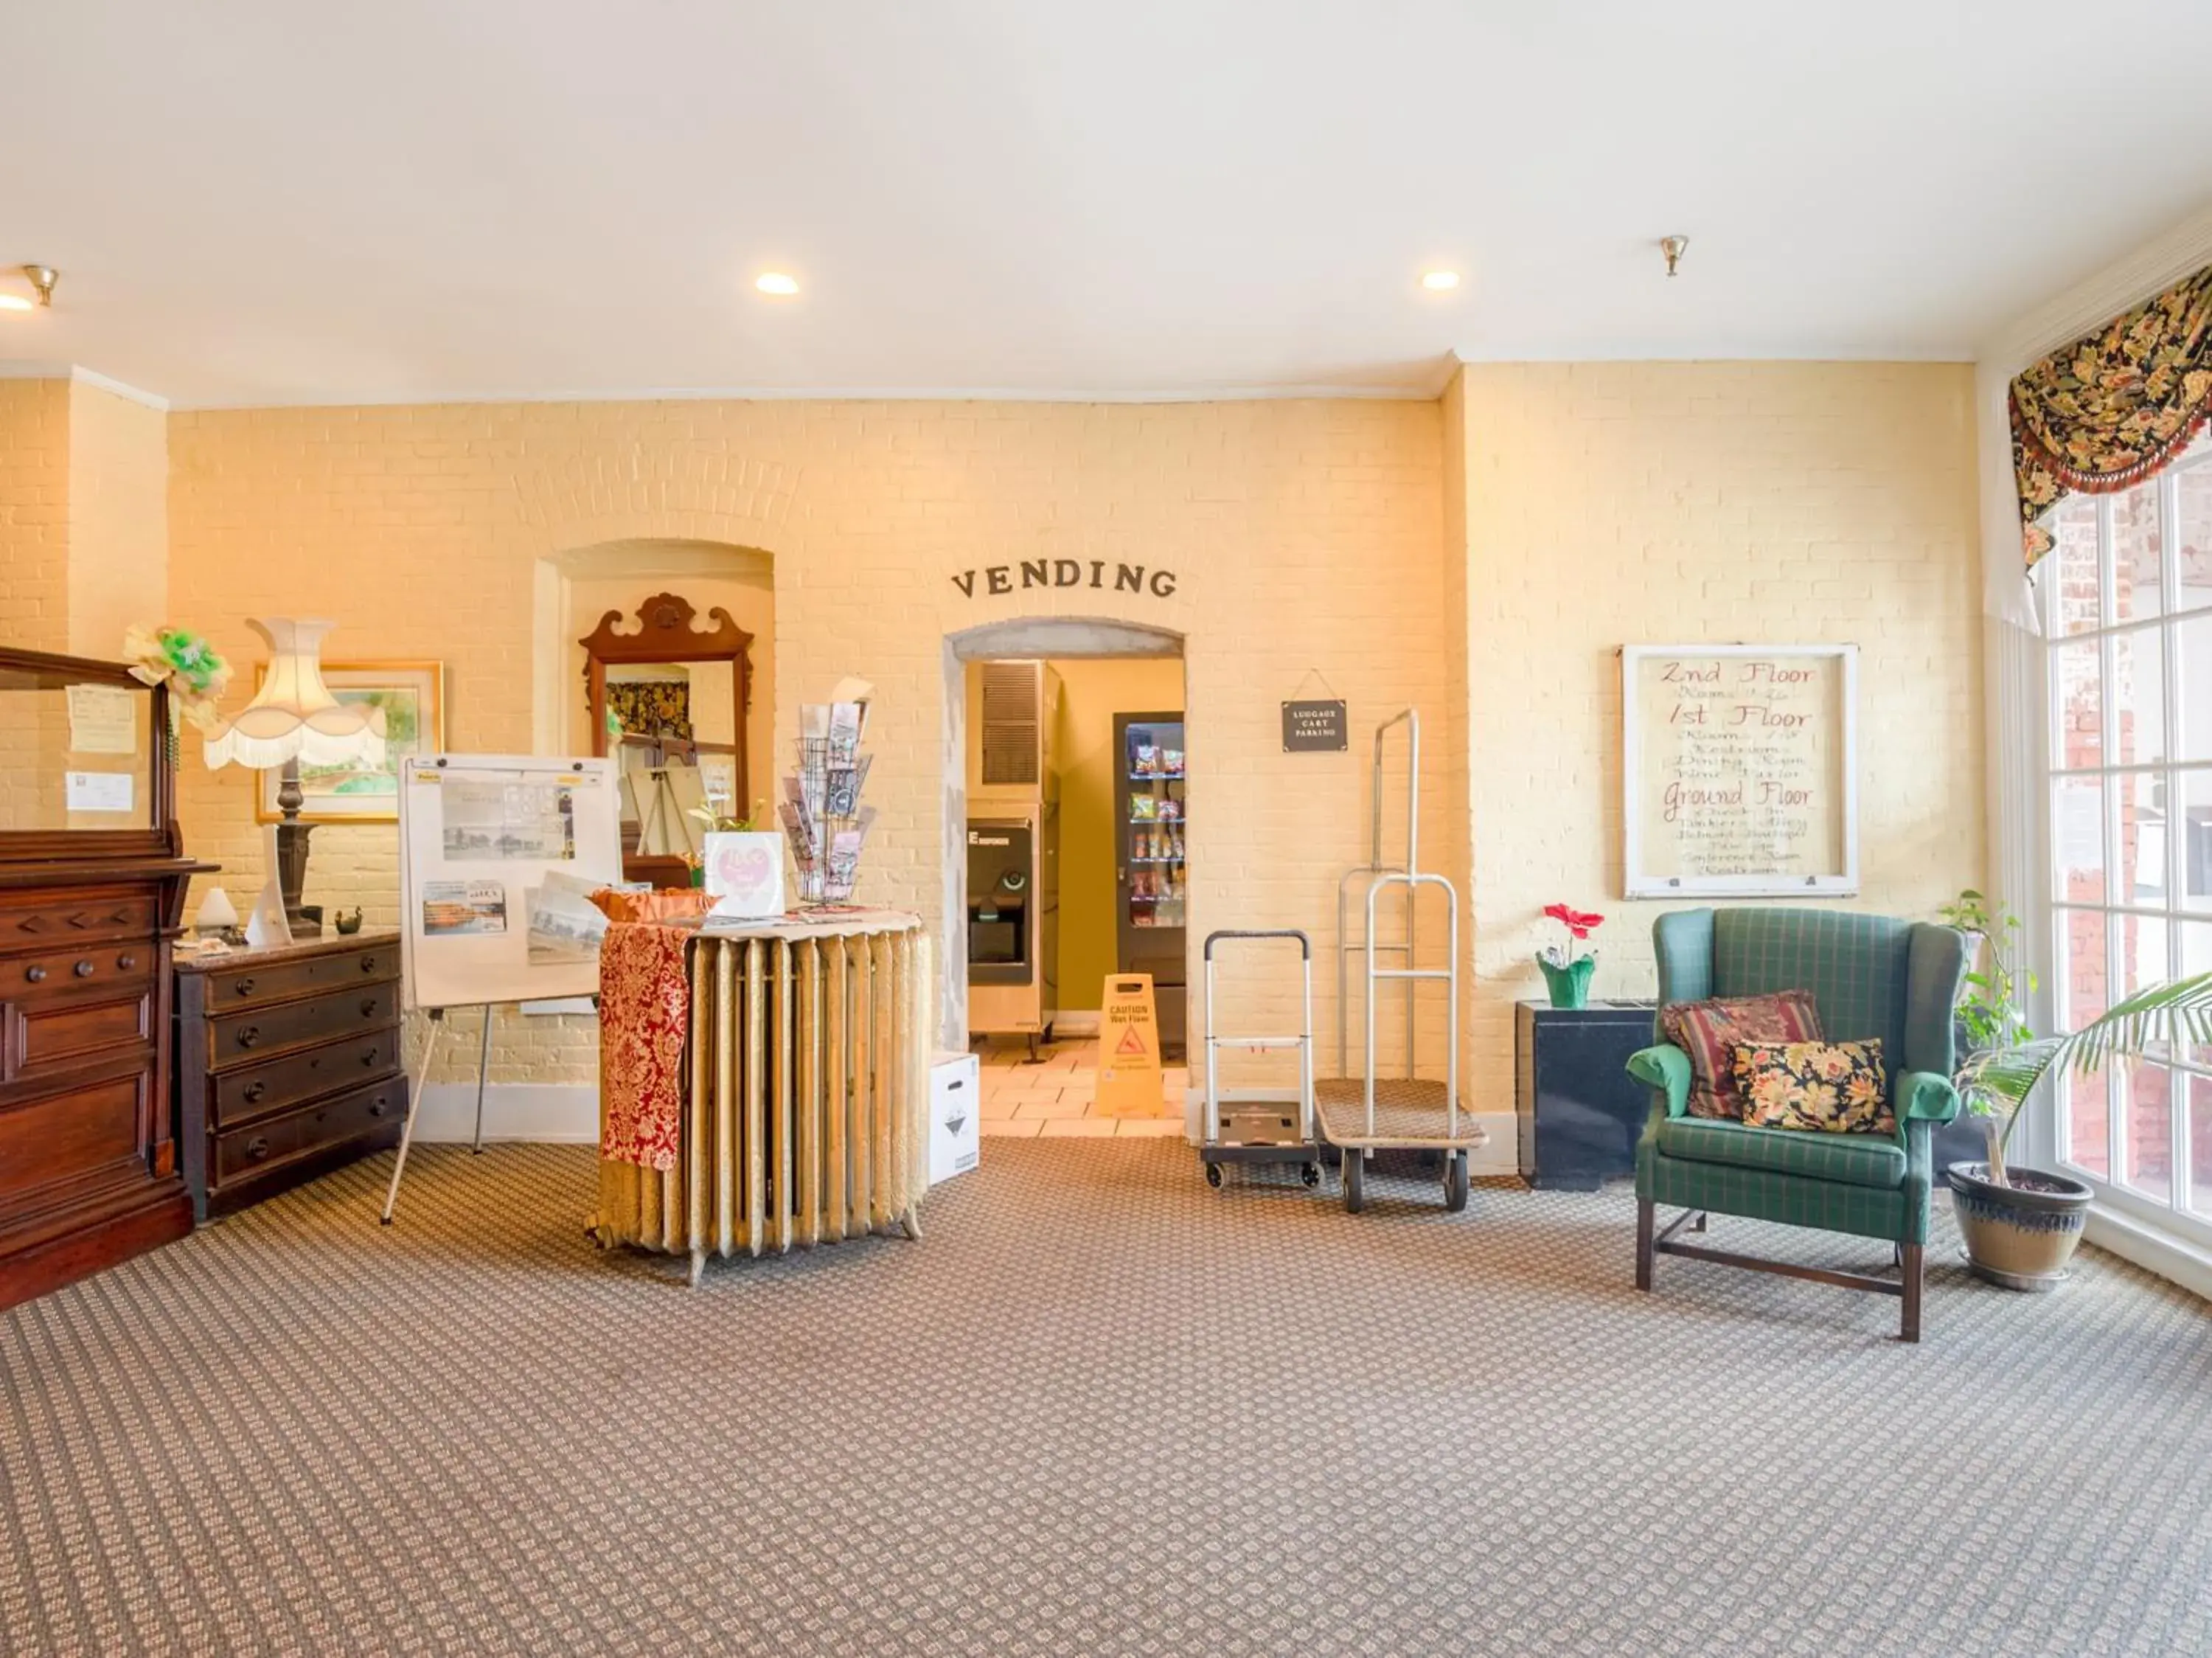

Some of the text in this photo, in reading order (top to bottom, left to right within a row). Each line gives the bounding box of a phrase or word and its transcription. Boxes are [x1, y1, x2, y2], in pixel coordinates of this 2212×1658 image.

[951, 558, 1177, 599] VENDING
[1660, 662, 1816, 683] 2nd Floor
[1301, 719, 1327, 727] CART
[1669, 704, 1812, 726] 1st Floor
[1755, 780, 1815, 805] Floor
[1109, 1005, 1148, 1014] CAUTION
